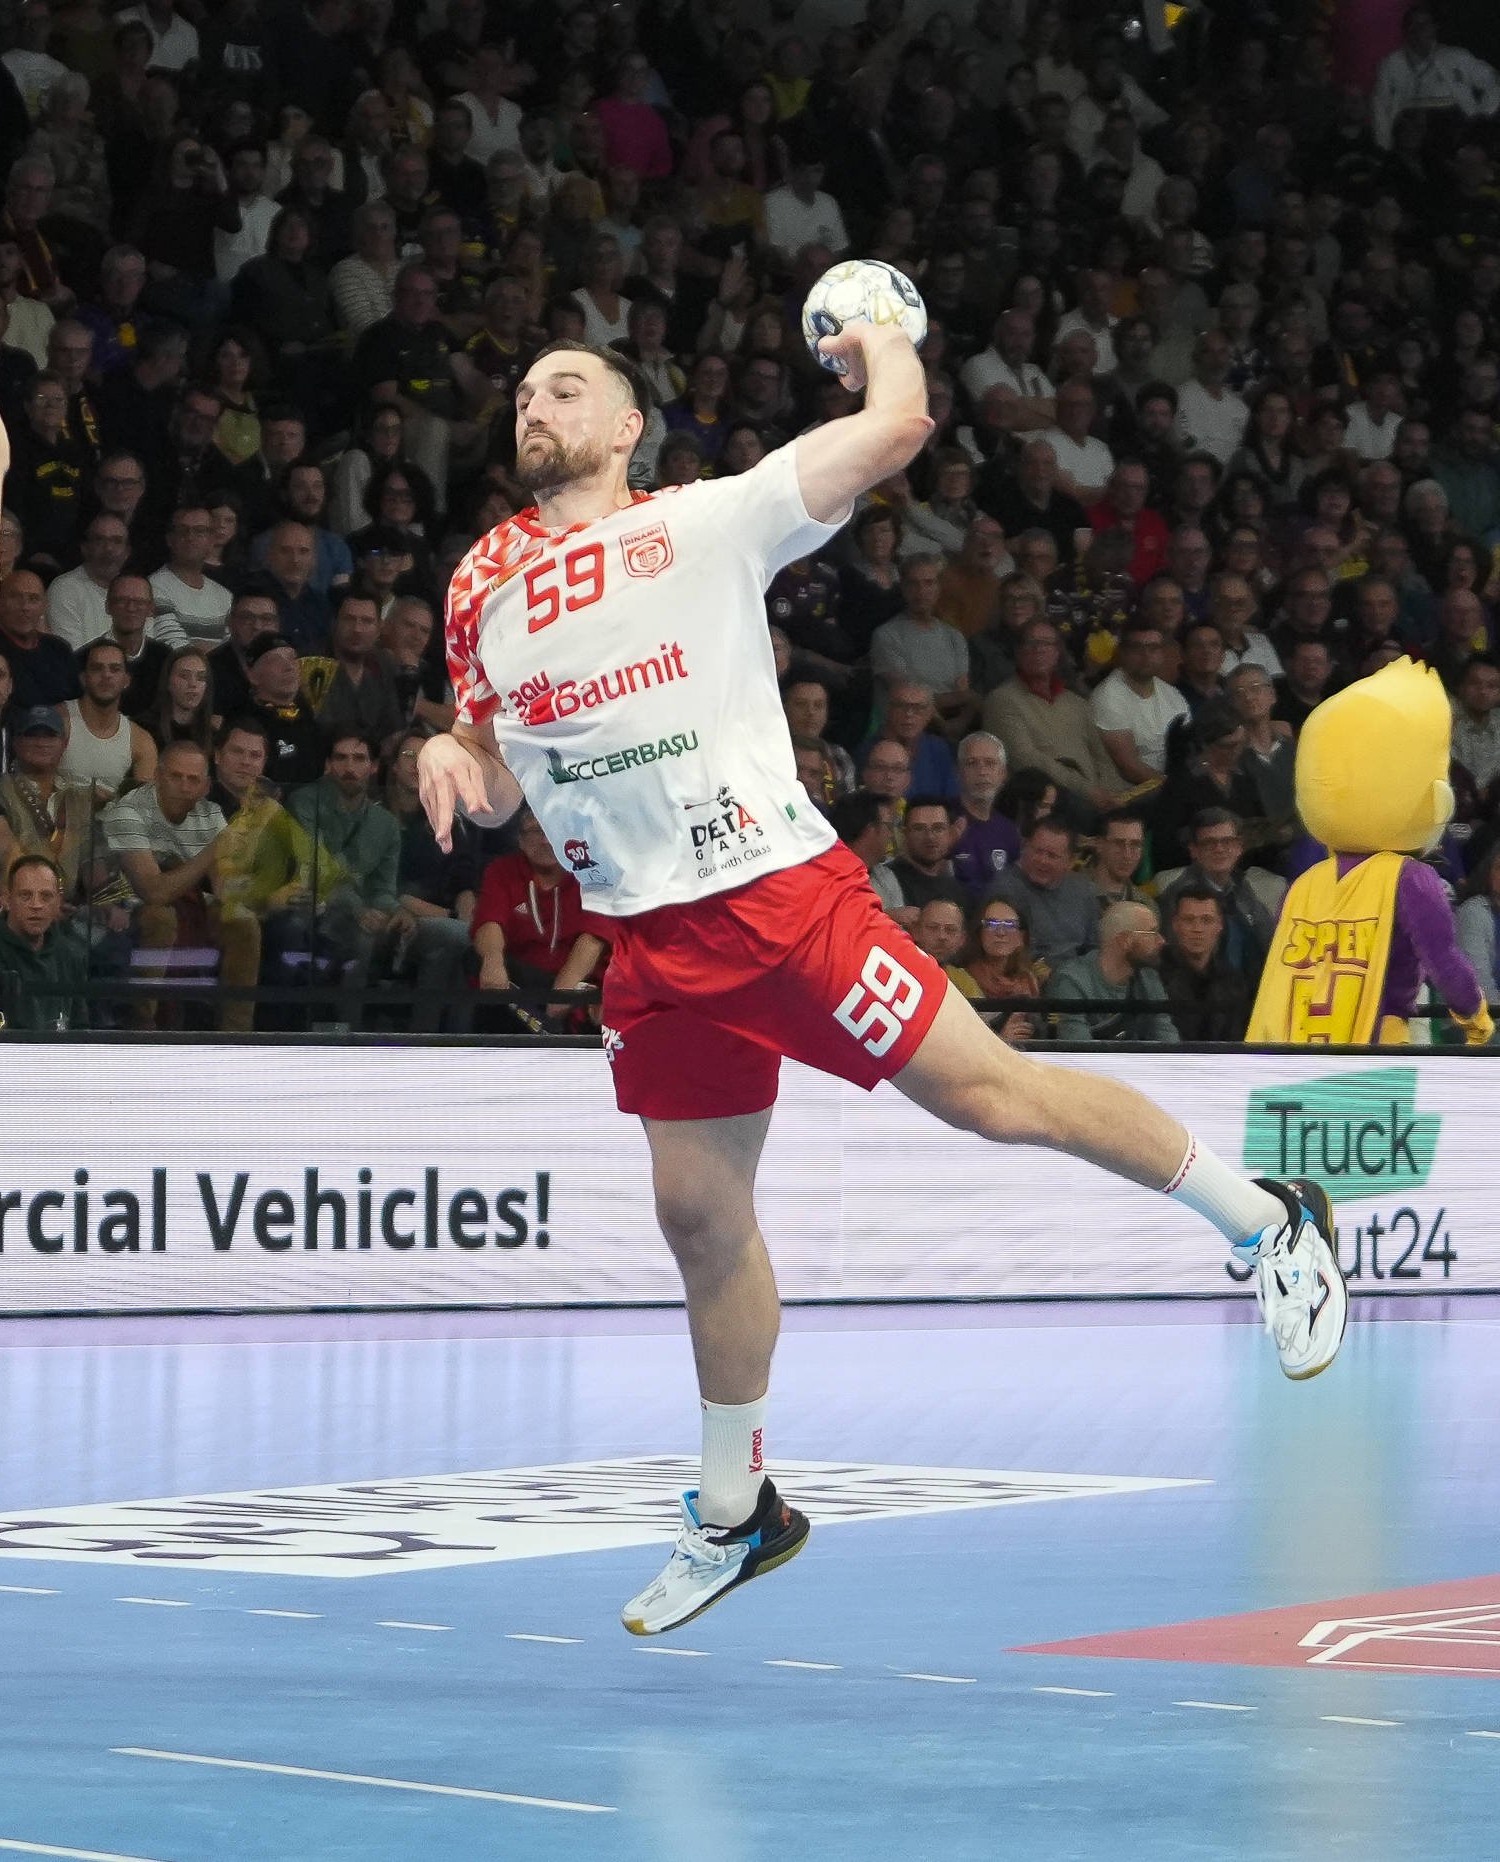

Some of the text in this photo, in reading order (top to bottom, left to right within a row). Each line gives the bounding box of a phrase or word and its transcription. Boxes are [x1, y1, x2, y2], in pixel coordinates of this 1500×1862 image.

[523, 541, 605, 634] 59
[554, 640, 689, 719] Baumit
[690, 806, 758, 848] DETA
[695, 826, 764, 861] GASS
[832, 944, 924, 1058] 59
[1285, 970, 1368, 1044] H
[1265, 1100, 1421, 1175] Truck
[196, 1166, 551, 1251] Vehicles!
